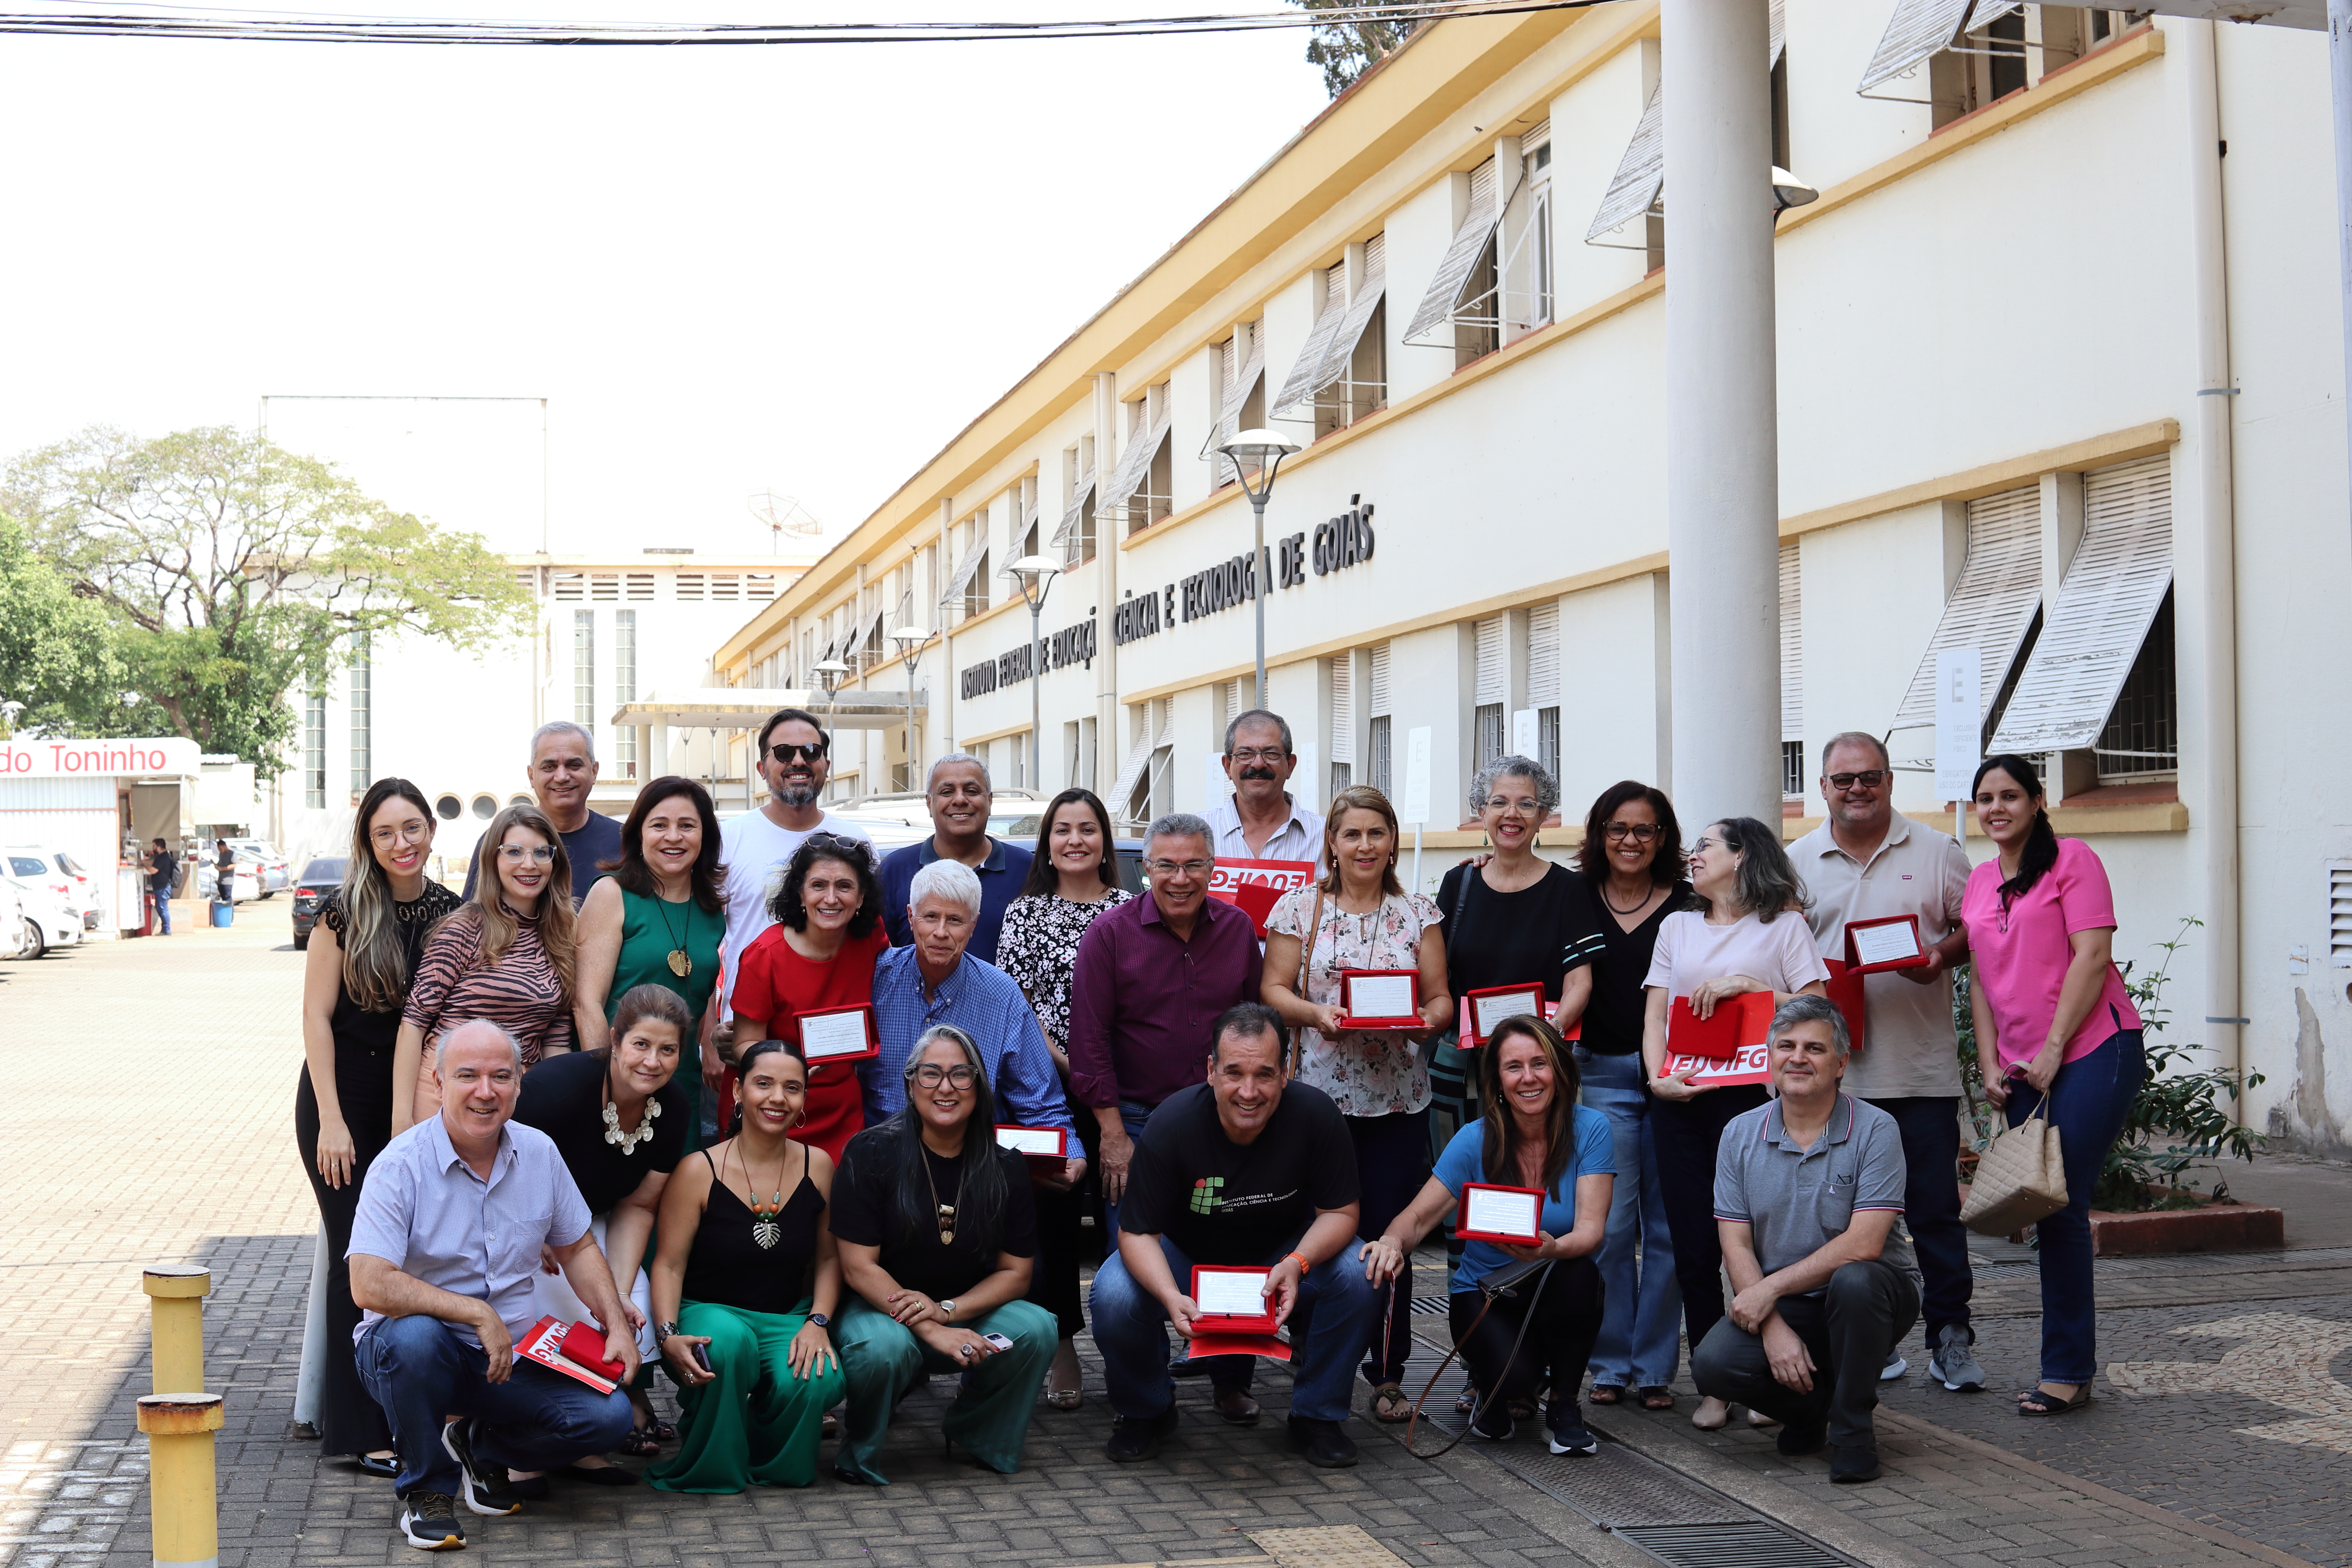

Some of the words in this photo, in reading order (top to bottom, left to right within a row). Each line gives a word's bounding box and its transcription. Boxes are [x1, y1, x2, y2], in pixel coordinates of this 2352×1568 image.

[962, 659, 996, 700] INSTITUTO
[999, 644, 1033, 688] FEDERAL
[1052, 606, 1096, 670] EDUCAÇÃ
[1113, 590, 1160, 646] CIÊNCIA
[1164, 584, 1174, 628] E
[1180, 546, 1272, 623] TECNOLOGA
[1279, 532, 1305, 589] DE
[1313, 494, 1375, 576] GOIÁS
[1952, 667, 1964, 702] E
[0, 746, 32, 773] do
[49, 744, 166, 772] Toninho
[1942, 768, 1973, 778] OBRIGATÓRIO
[1221, 1197, 1245, 1205] INSTITUTO
[1272, 1189, 1297, 1201] TECNOLOGIA
